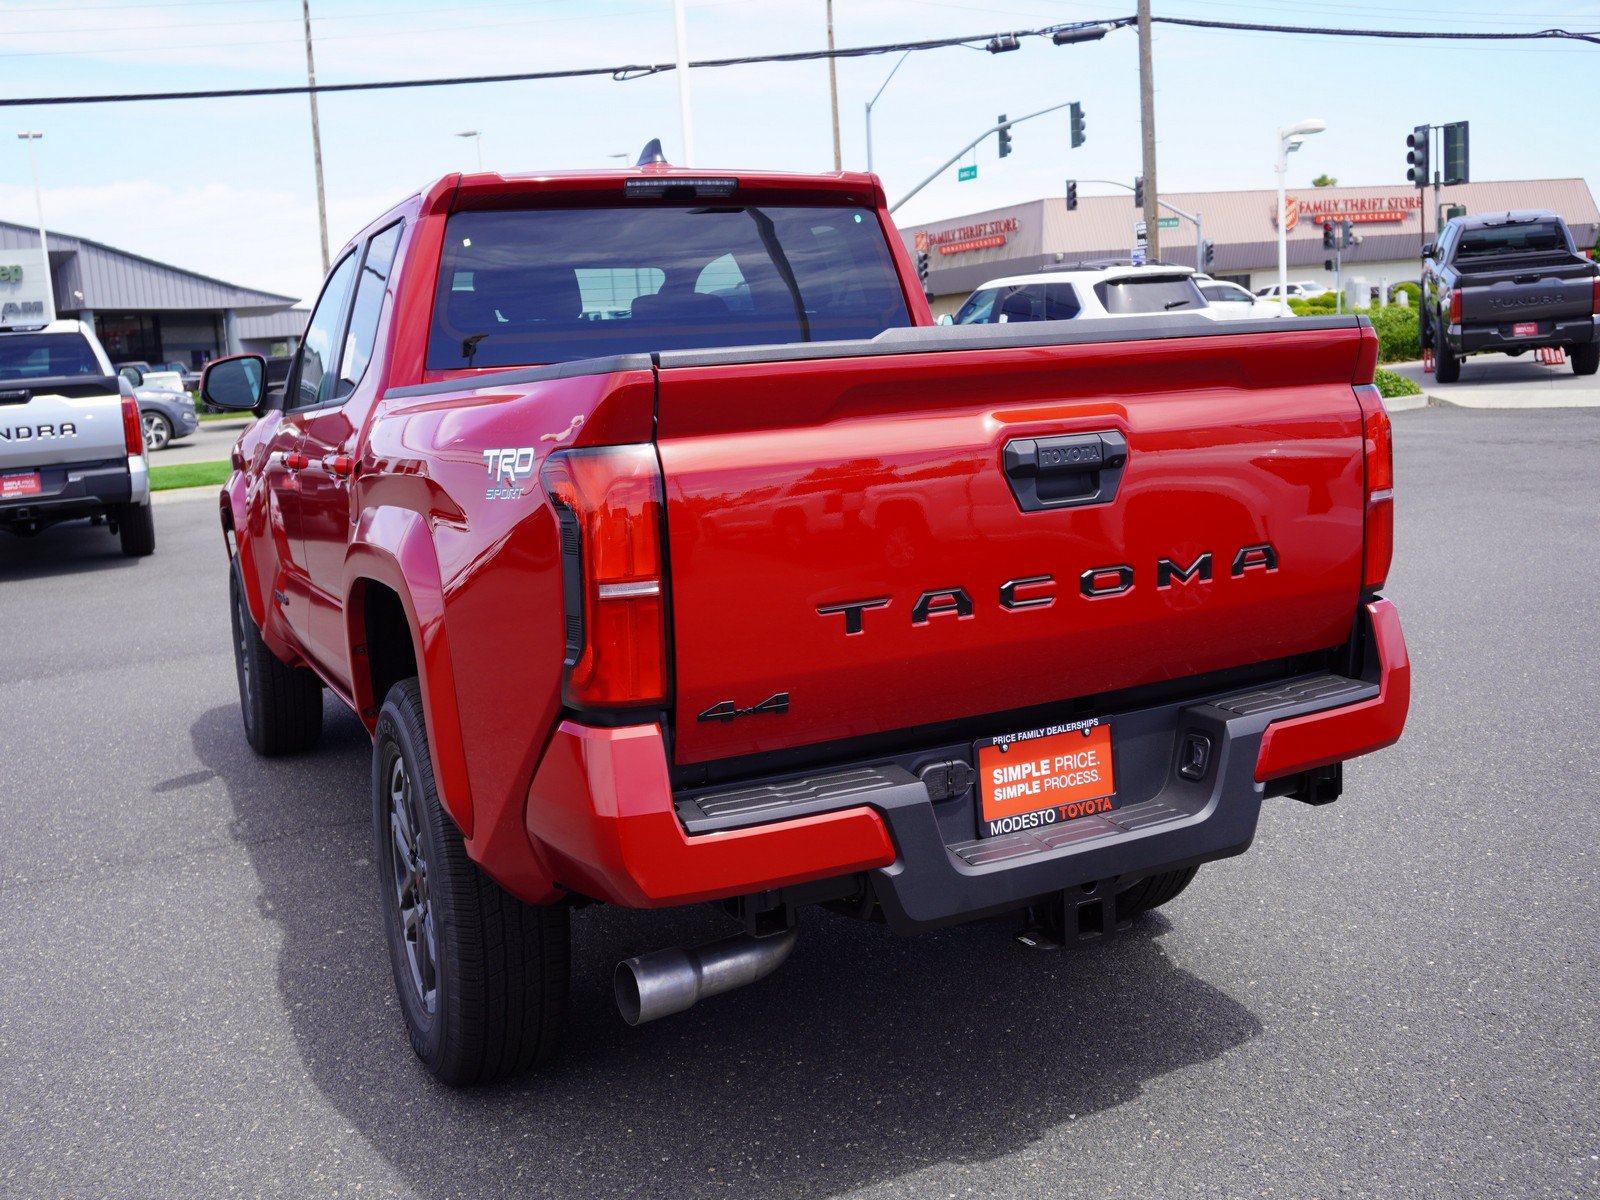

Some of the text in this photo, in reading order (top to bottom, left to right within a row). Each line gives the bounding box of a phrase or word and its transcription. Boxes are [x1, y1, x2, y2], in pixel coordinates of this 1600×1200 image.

[1299, 198, 1341, 214] FAMILY
[1344, 197, 1384, 212] THRIFT
[1387, 196, 1423, 211] STORE
[1368, 212, 1402, 220] CENTER
[928, 229, 956, 247] FAMILY
[957, 222, 988, 241] THRIFT
[989, 217, 1018, 236] STORE
[941, 236, 1001, 254] DONATION CENTER
[1489, 295, 1565, 309] TUNDRA
[482, 447, 535, 482] TRD
[1041, 445, 1100, 463] TOYOTA
[485, 487, 525, 500] SPORT
[816, 543, 1279, 635] TACOMA
[992, 718, 1099, 745] PRICE FAMILY DEALERSHIPS
[992, 750, 1100, 785] SIMPLE PRICE.
[993, 769, 1101, 801] SIMPLE PROCESS.
[990, 797, 1113, 836] MODESTO TOYOTA
